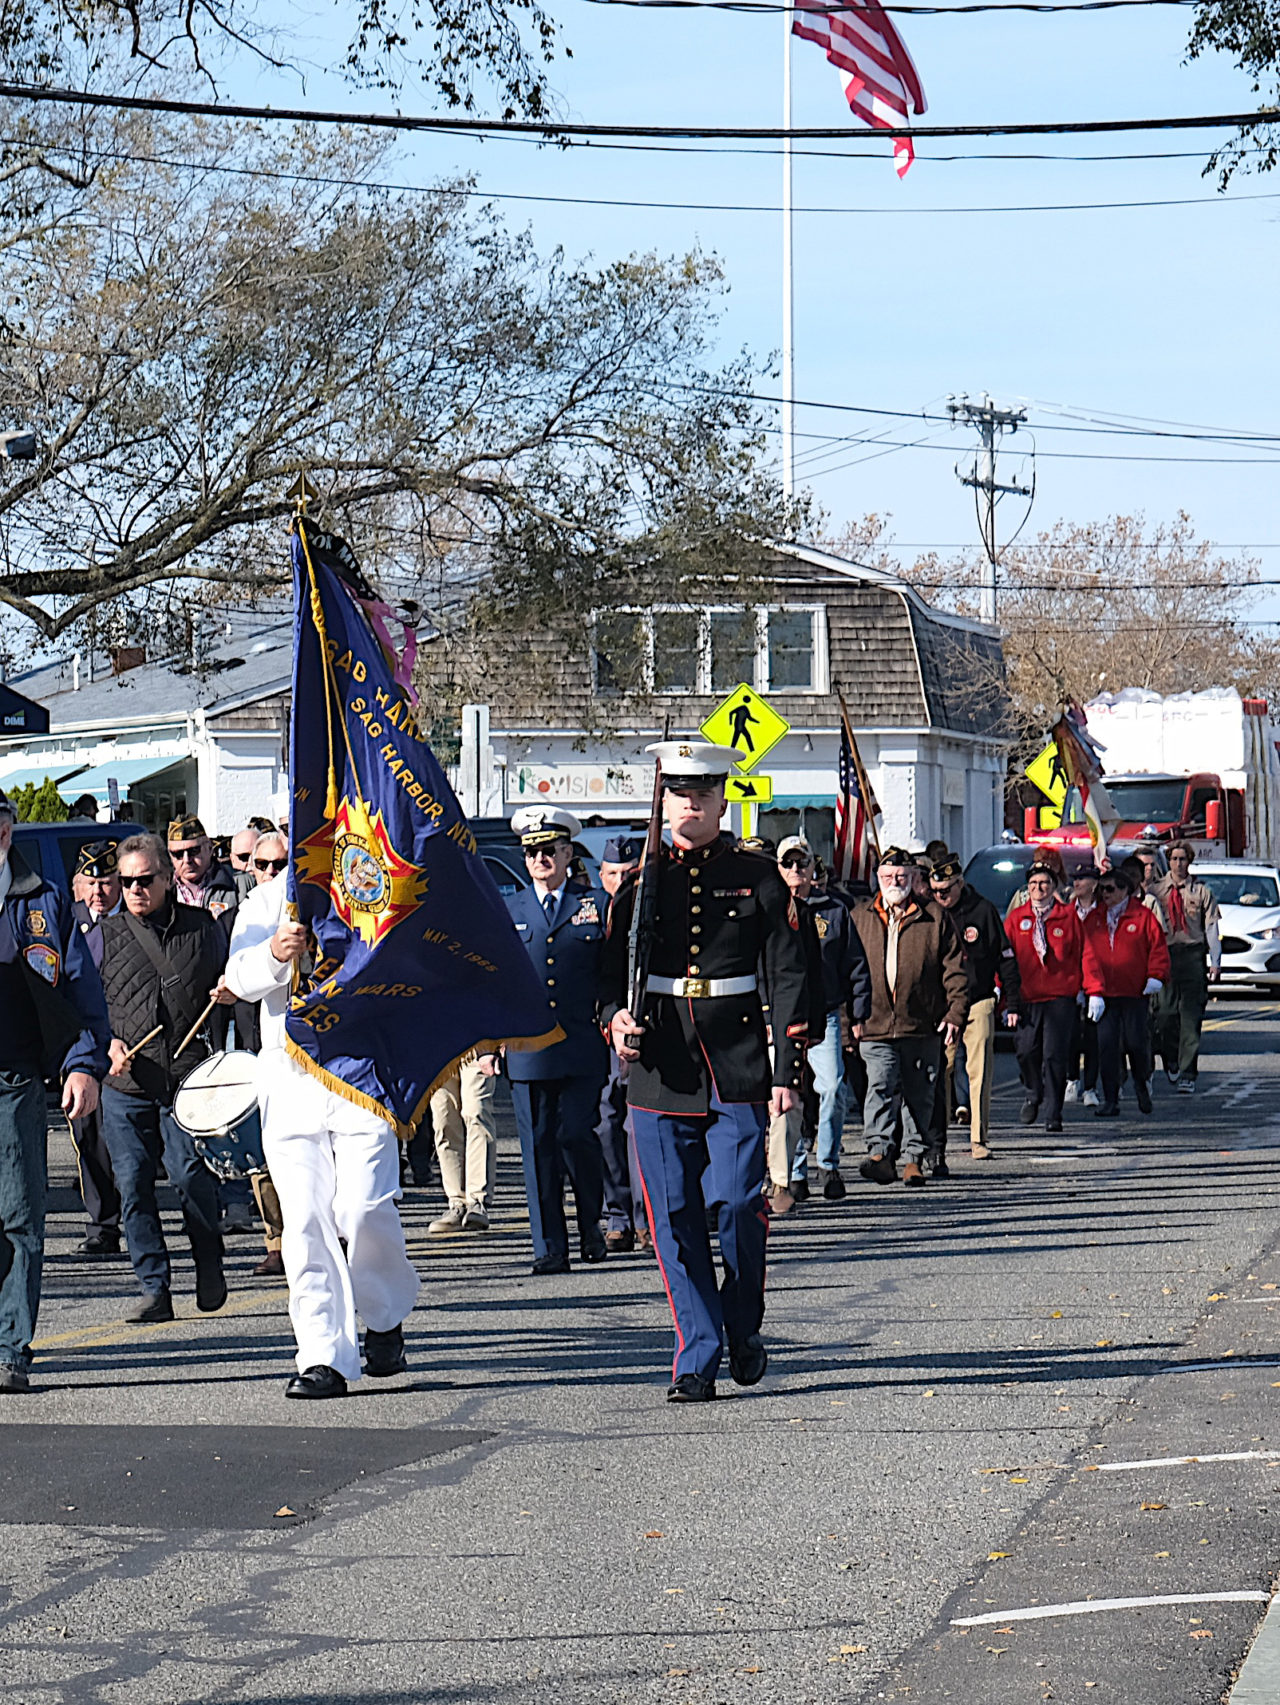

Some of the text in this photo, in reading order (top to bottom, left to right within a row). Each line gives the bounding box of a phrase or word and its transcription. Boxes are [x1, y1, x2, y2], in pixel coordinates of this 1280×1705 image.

[4, 716, 25, 726] DIME
[351, 697, 382, 738] SAG
[380, 743, 444, 827] HARBOR,
[422, 927, 449, 944] MAY
[351, 983, 423, 998] WARS
